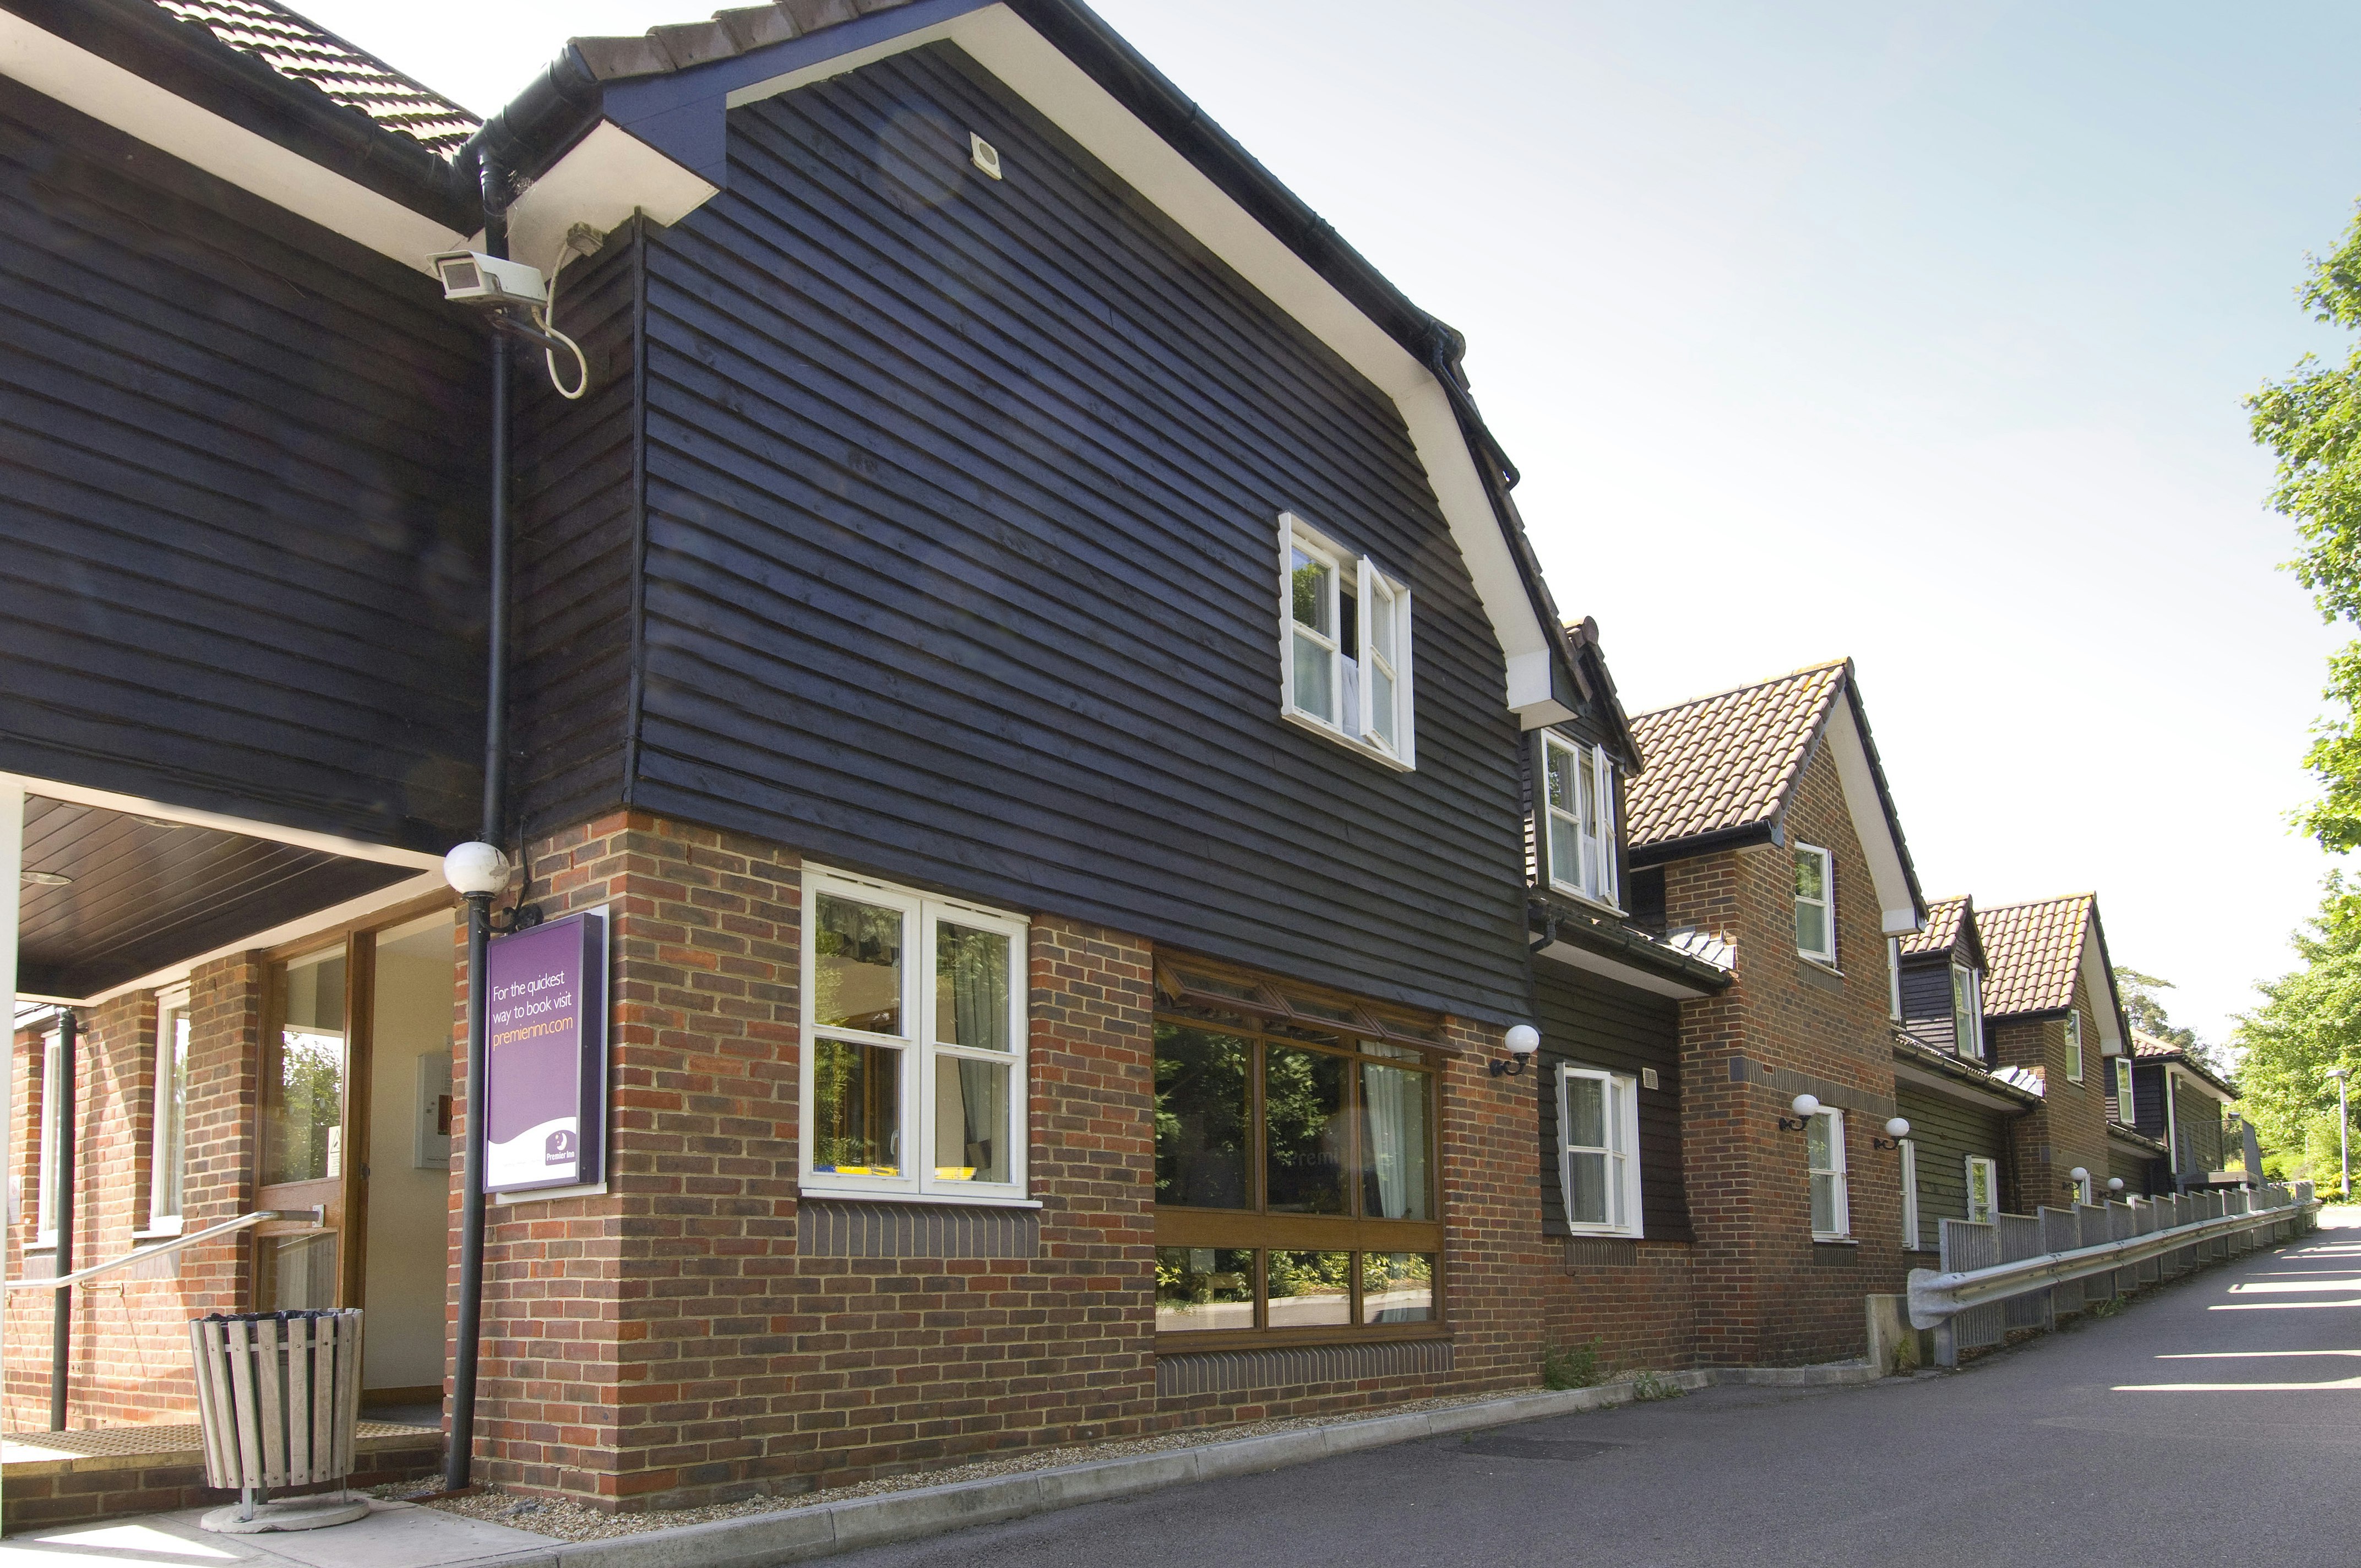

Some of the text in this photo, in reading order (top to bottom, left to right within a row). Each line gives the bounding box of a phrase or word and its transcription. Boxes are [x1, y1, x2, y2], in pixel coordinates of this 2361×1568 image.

[493, 971, 565, 1001] For the quickest
[492, 991, 572, 1025] way to book visit
[493, 1016, 573, 1052] premierinn.com
[546, 1152, 566, 1161] Premier
